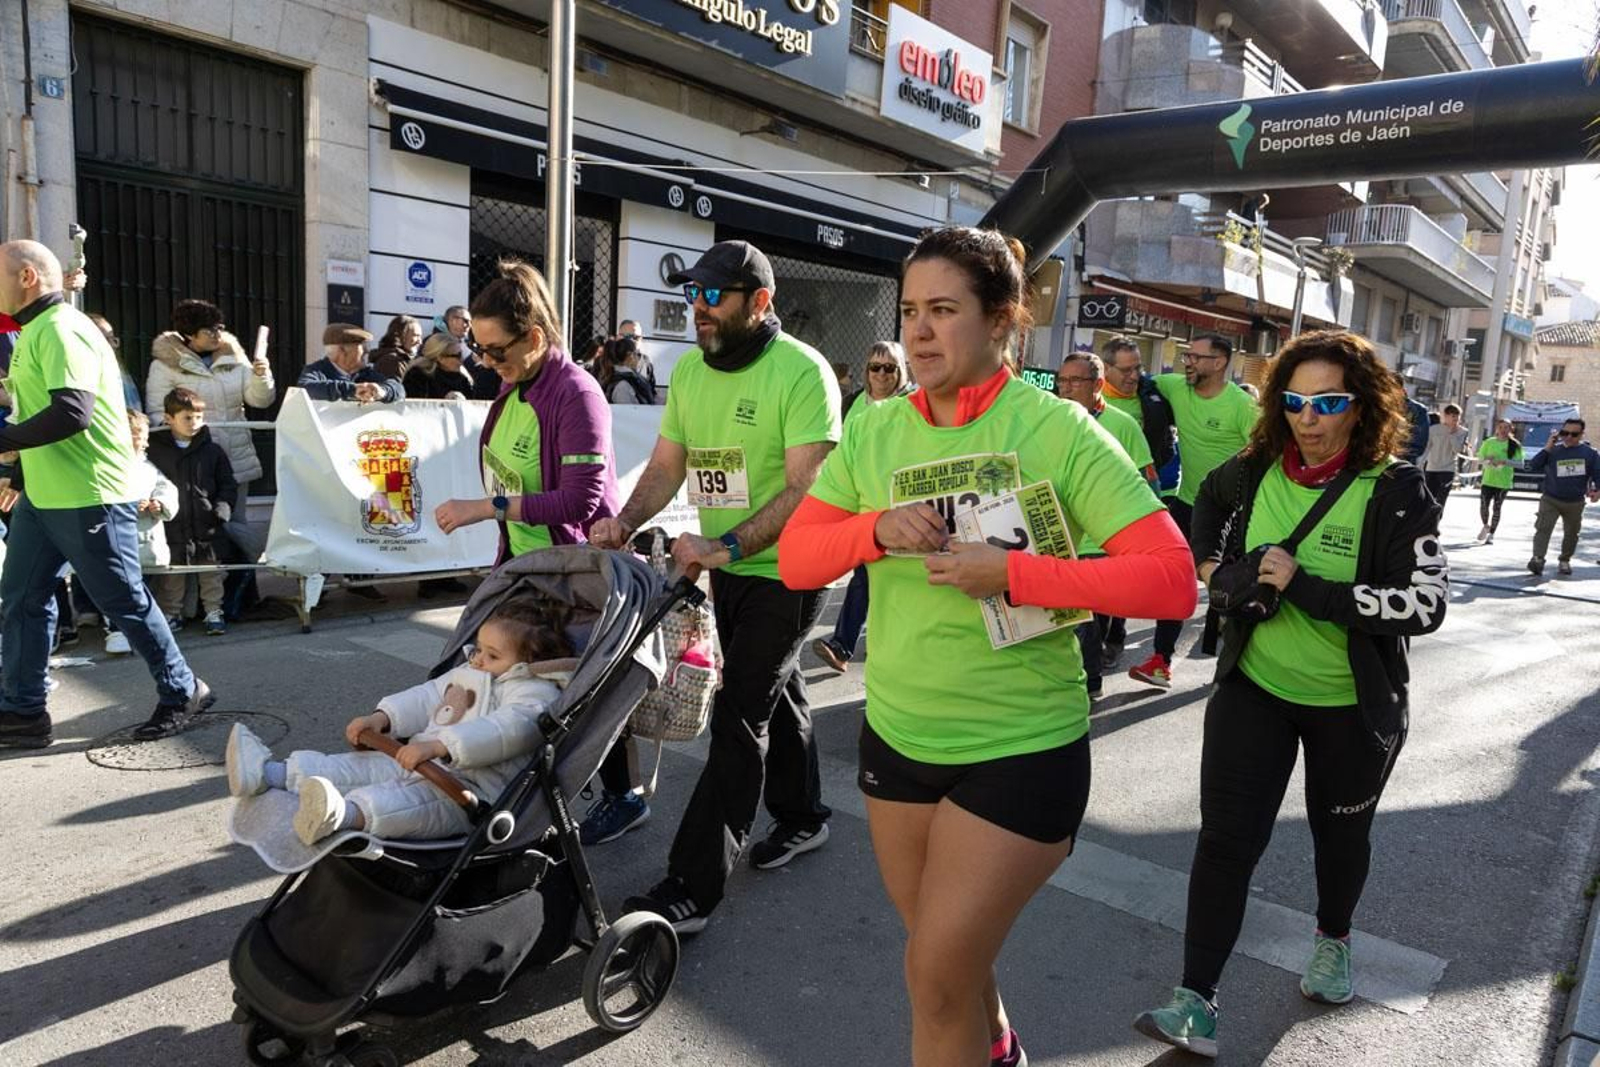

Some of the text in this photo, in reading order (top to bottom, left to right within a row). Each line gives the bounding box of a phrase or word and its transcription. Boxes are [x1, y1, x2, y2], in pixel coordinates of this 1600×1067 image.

[759, 8, 813, 57] Legal
[45, 79, 58, 97] 6
[898, 77, 940, 113] diseño
[1261, 99, 1464, 134] Patronato Municipal de
[1259, 122, 1411, 153] Deportes de Jaén
[817, 224, 844, 247] PASOS
[1023, 370, 1055, 390] 06:06
[697, 471, 727, 494] 139
[912, 469, 926, 481] SAN
[930, 464, 949, 478] JUAN
[908, 480, 936, 496] CARRERA
[1027, 508, 1050, 544] CARRERA
[1044, 509, 1060, 528] SAN
[1050, 530, 1067, 553] JUAN
